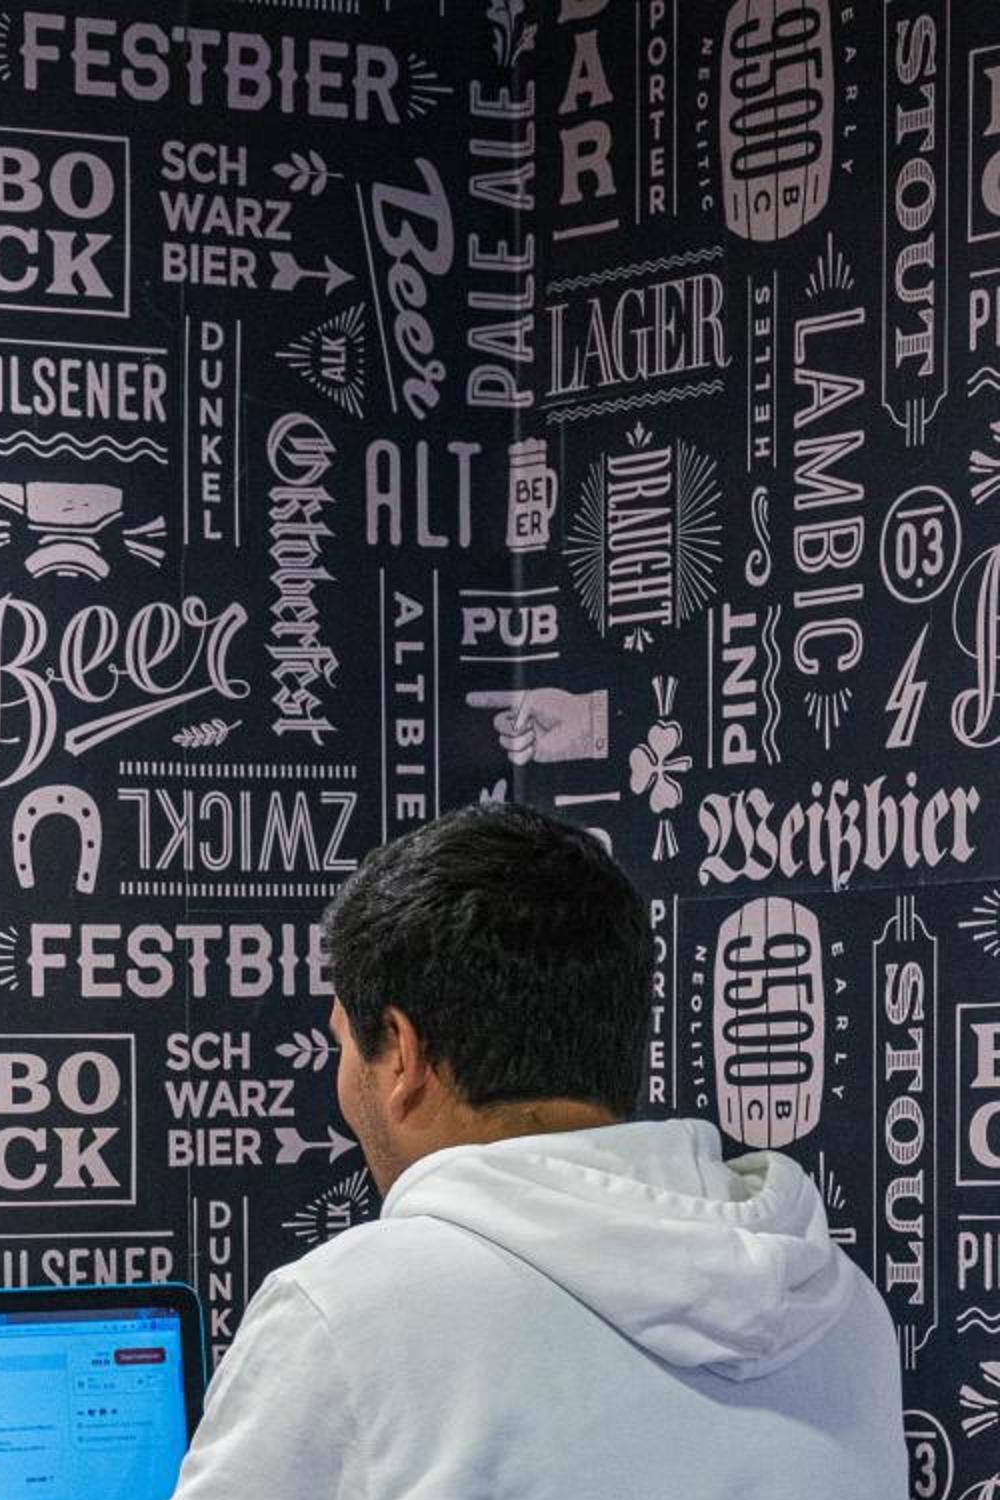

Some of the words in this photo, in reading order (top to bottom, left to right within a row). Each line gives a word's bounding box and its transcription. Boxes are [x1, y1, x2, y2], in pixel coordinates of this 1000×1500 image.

[18, 11, 401, 124] FESTBIER
[468, 79, 536, 211] ALE
[556, 0, 617, 206] AR
[647, 0, 667, 215] PORTER
[695, 37, 714, 212] NEOLITIC
[729, 8, 823, 182] 9500
[840, 6, 859, 174] EARLY
[159, 190, 292, 241] WARZ
[160, 140, 248, 187] SCH
[894, 14, 937, 378] STOUT
[162, 241, 258, 289] BIER
[368, 157, 455, 421] Beer
[467, 233, 534, 409] PALE
[544, 271, 733, 397] LAGER
[199, 321, 224, 540] DUNKEL
[320, 335, 347, 383] ALK
[754, 285, 771, 458] HELLES
[365, 438, 482, 549] ALT
[515, 476, 544, 500] BE
[516, 512, 543, 537] ER
[607, 445, 673, 628] DRAUGHT
[793, 307, 866, 675] LAMBIC
[263, 412, 340, 747] Oktoberfest
[461, 604, 559, 648] PUB
[394, 591, 426, 821] ALTBIE
[721, 602, 757, 765] PINT
[117, 787, 359, 872] ZWICKL
[697, 771, 981, 893] Weißbier
[26, 921, 337, 1001] FESTBIE
[690, 944, 709, 1109] NEOLITIC
[722, 933, 815, 1086] 9500
[830, 940, 849, 1100] EARLY
[164, 1079, 295, 1119] WARZ
[165, 1031, 251, 1072] SCH
[167, 1127, 263, 1168] BIER
[884, 961, 925, 1305] STOUT
